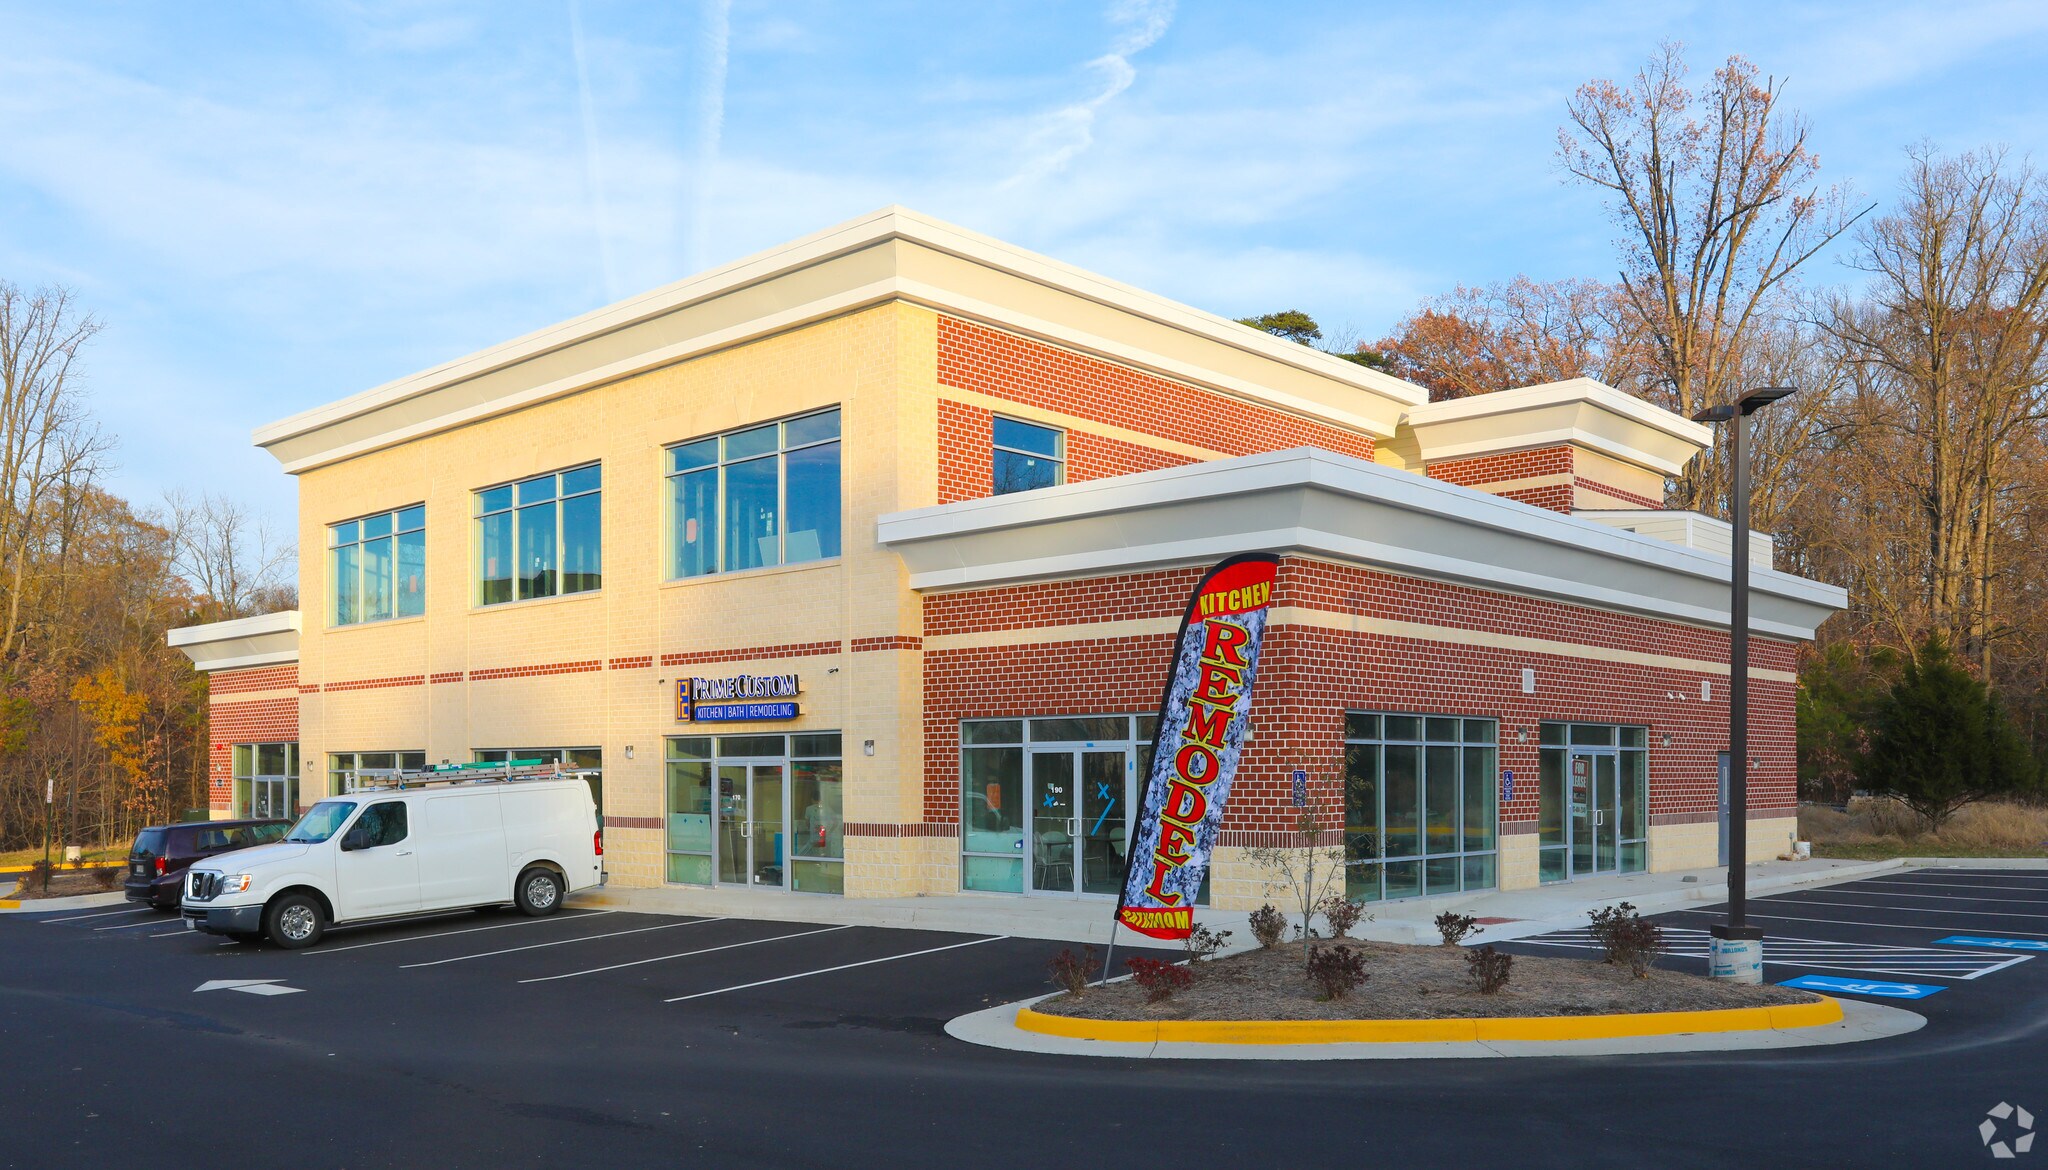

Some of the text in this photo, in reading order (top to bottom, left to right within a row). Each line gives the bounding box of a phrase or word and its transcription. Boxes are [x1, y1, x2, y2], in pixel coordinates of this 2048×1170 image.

[1199, 580, 1271, 615] KITCHEN
[692, 674, 797, 700] PRIME CUSTOM
[697, 704, 792, 719] KITCHEN BATH REMODELING
[1145, 618, 1250, 907] REMODEL
[1575, 762, 1584, 774] FOR
[1051, 786, 1063, 794] 190
